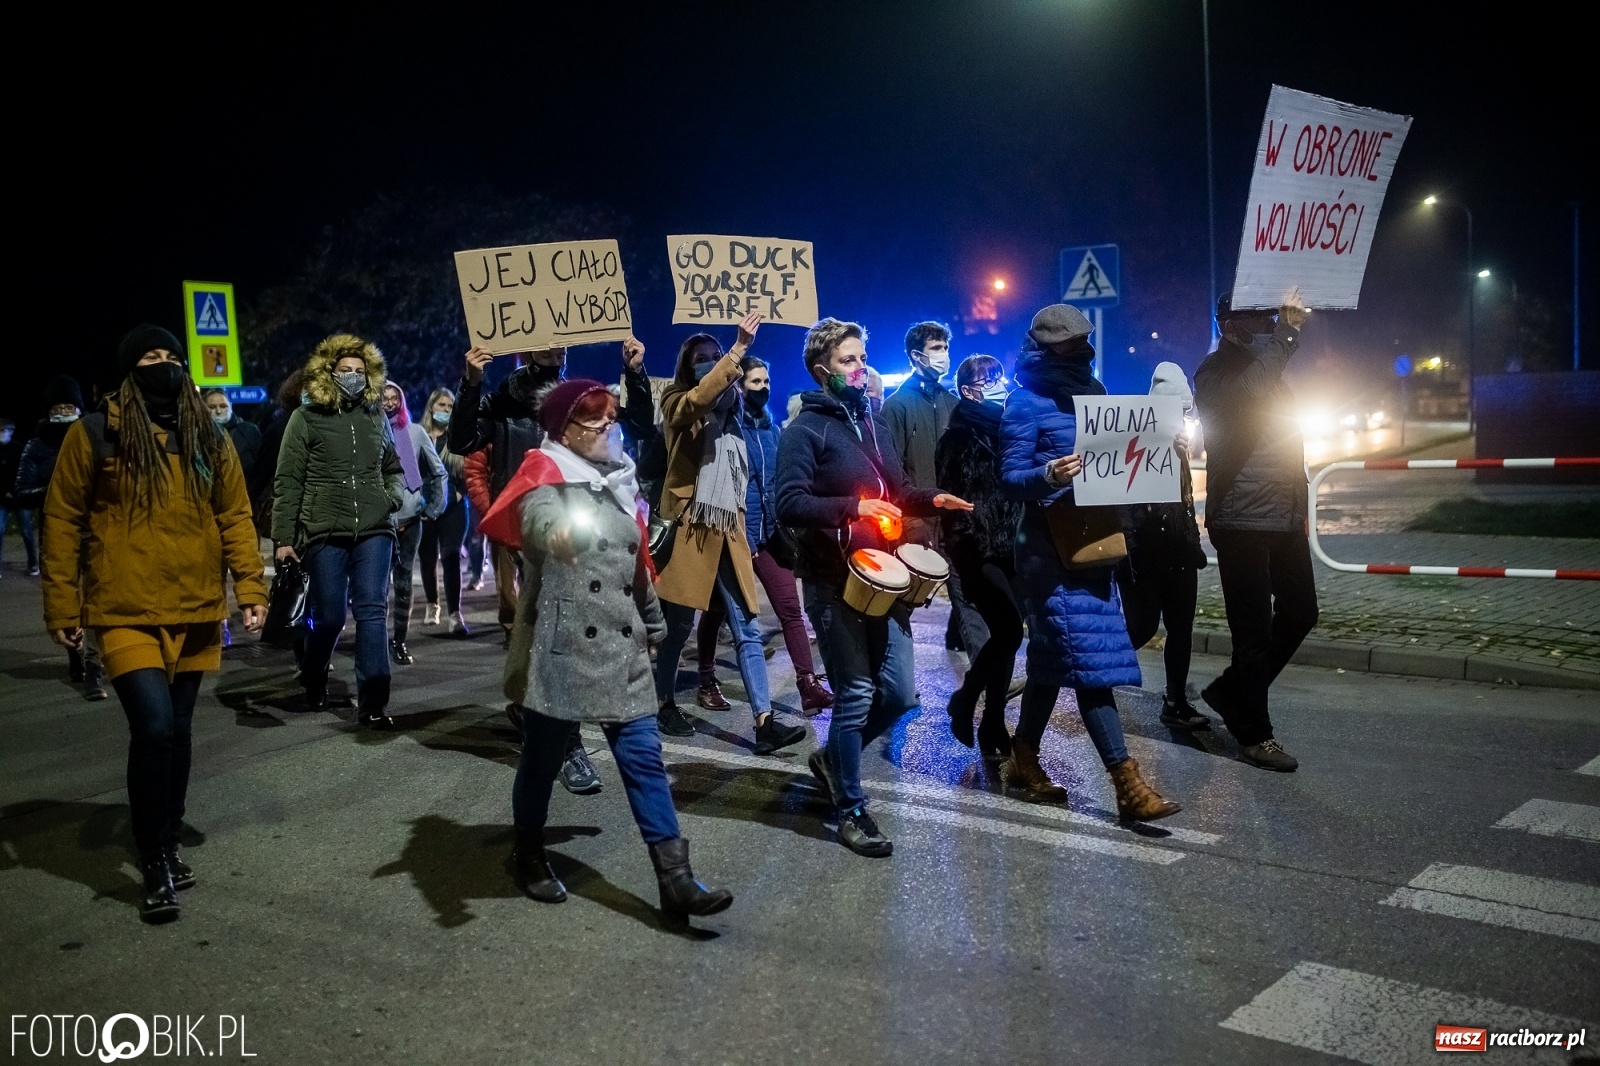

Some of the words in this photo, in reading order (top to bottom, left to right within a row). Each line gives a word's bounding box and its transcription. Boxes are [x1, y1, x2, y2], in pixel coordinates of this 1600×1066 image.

[1264, 119, 1288, 168] W
[1293, 124, 1393, 182] OBRONIE
[1254, 189, 1365, 255] WOLNOŚCI
[468, 251, 537, 293] JEJ
[551, 249, 618, 283] CIAŁO
[675, 240, 714, 269] GO
[729, 240, 810, 271] DUCK
[678, 269, 799, 300] YOURSELF,
[476, 300, 536, 340] JEJ
[546, 287, 630, 329] WYBÓR
[1084, 405, 1158, 435] WOLNA
